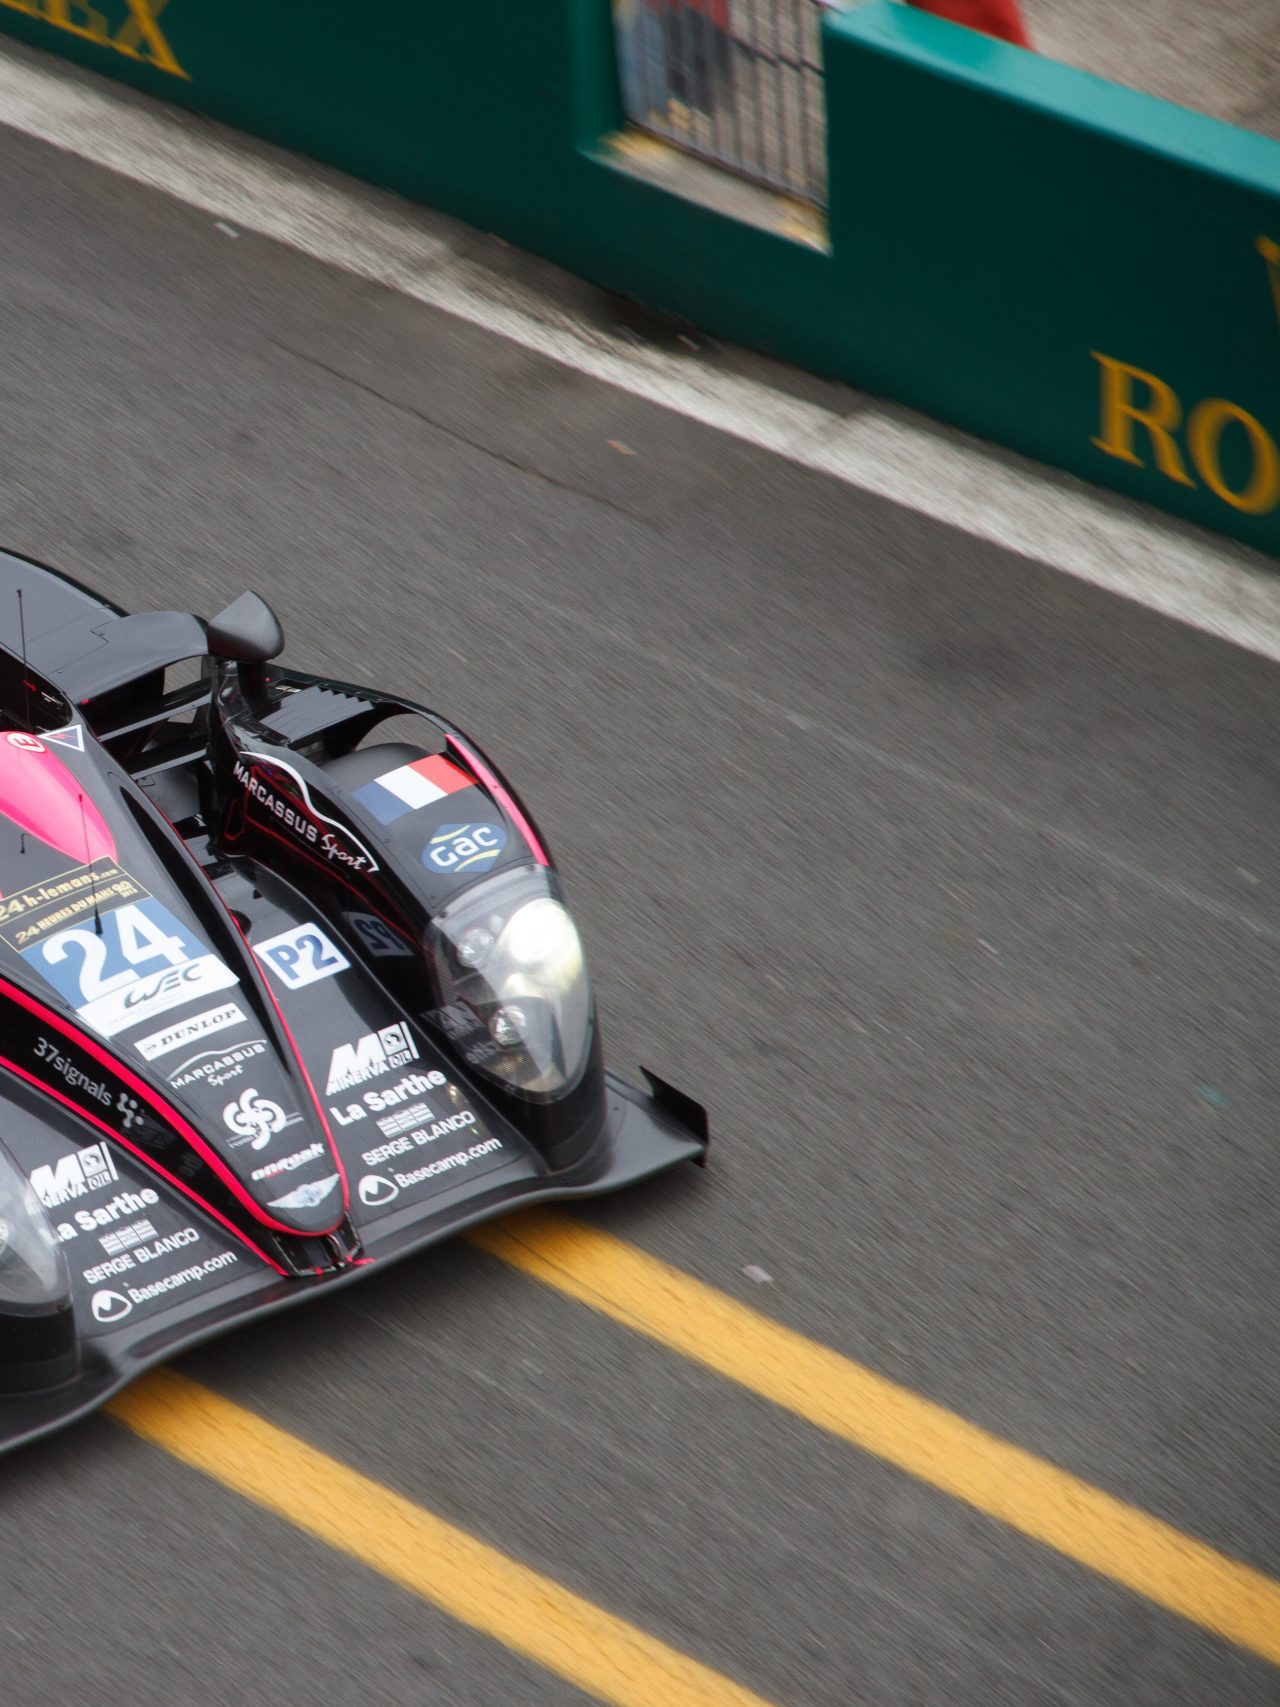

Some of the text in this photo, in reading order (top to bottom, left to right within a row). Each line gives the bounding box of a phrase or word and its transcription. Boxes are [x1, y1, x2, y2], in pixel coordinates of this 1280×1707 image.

[233, 761, 367, 870] MARCASSUS Sport
[15, 925, 41, 944] 24
[37, 904, 75, 931] HEURES
[70, 897, 88, 912] DU
[42, 904, 191, 1002] 24
[266, 934, 338, 981] P2
[123, 963, 202, 1009] WEC
[160, 1009, 237, 1047] DUNLOP
[33, 1036, 113, 1107] 37signals
[171, 1044, 266, 1090] MARCASSUS
[207, 1064, 244, 1088] Sport
[329, 1070, 447, 1127] La Sarthe
[361, 1137, 415, 1166] SERGE
[410, 1110, 476, 1146] BLANCO
[393, 1137, 503, 1188] Basecamp.com
[74, 1188, 160, 1231] Sarthe
[83, 1227, 200, 1285] SERGE BLANCO
[128, 1250, 239, 1304] Basecamp.com
